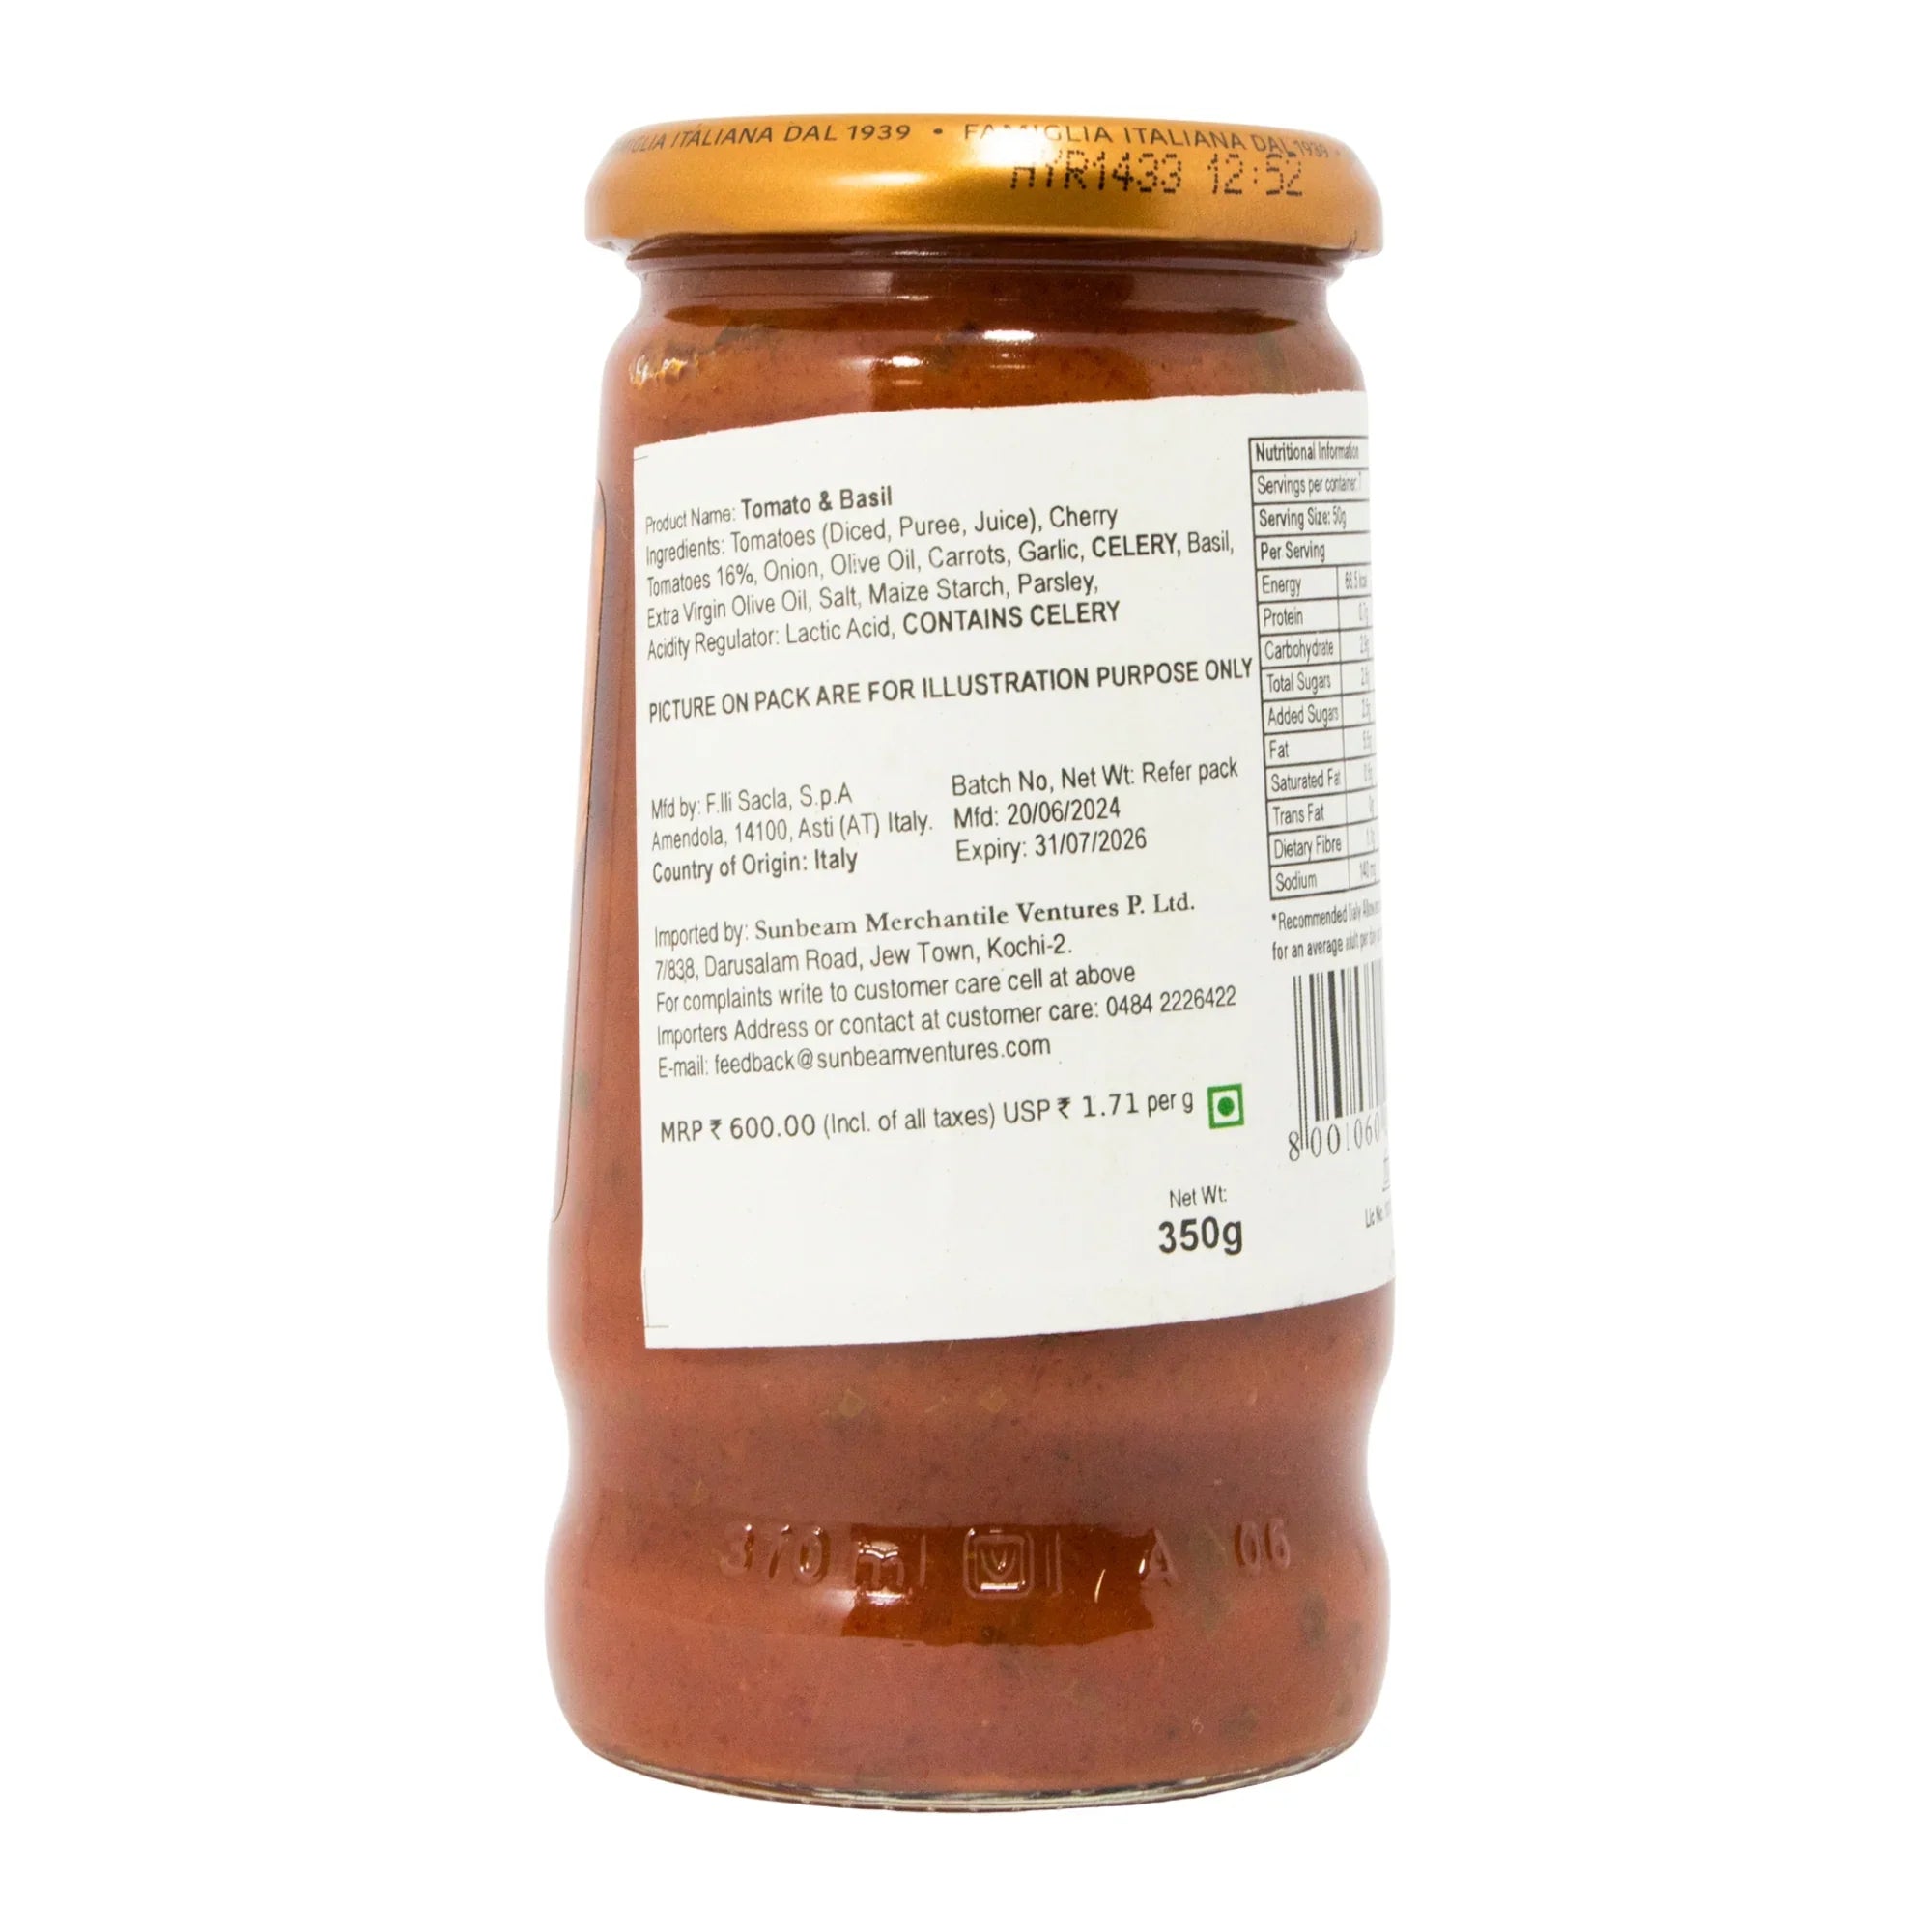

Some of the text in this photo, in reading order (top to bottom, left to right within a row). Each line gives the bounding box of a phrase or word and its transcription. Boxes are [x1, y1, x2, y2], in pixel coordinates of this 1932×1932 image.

[670, 122, 911, 148] ITALIANA DAL 1939
[1124, 128, 1246, 147] ITALIANA
[1253, 135, 1294, 154] DAL
[1206, 152, 1303, 195] 12:52
[1257, 440, 1359, 463] Nutritional Information
[1258, 475, 1322, 497] Servings per
[646, 485, 892, 532] Product Name: Tomato & Basil
[1260, 505, 1346, 530] Serving Size: 50g
[647, 505, 1118, 565] Ingredients: Tomatoes (Diced, Puree, Juice), Cherry
[1261, 539, 1325, 562] Per Serving
[647, 530, 1234, 596] Tomatoes 16%, Onion, Olive Oil, Carrots, Garlic, CELERY, Basil,
[648, 571, 1097, 628] Extra Virgin Olive Oil, Salt, Maize Starch, Parsley,
[1263, 576, 1301, 596] Energy
[648, 600, 1120, 661] Acidity Regulator: Lactic Acid, CONTAINS CELERY
[1264, 607, 1303, 626] Protein
[1265, 639, 1334, 665] Carbohydrate
[649, 657, 1252, 723] PICTURE ON PACK ARE FOR ILLUSTRATION PURPOSE ONLY
[1267, 670, 1331, 695] Total Sugars
[1268, 705, 1304, 725] Added
[1308, 701, 1339, 728] Sugars
[1269, 740, 1289, 759] Fat
[952, 756, 1238, 796] Batch No, Net Wt: Refer pack
[1271, 769, 1323, 792] Saturated
[1327, 769, 1341, 787] Fat
[652, 782, 852, 821] Mfd by: F.lli Sacla, S.p.A
[954, 796, 1121, 829] Mfd: 20/06/2024
[1273, 803, 1324, 825] Trans Fat
[652, 810, 933, 850] Amendola, 14100, Asti (AT) Italy.
[956, 827, 1147, 865] Expiry: 31/07/2026
[653, 847, 858, 884] Country of Origin: Italy
[1274, 837, 1312, 861] Dietary
[1316, 836, 1342, 853] Fibre
[1276, 871, 1317, 892] Sodium
[655, 892, 1194, 951] Imported by: Sunbeam Merchantile Ventures P. Ltd.
[705, 952, 799, 977] Darusalam
[806, 947, 863, 971] Road,
[870, 945, 910, 967] Jew
[917, 942, 980, 963] Town,
[987, 933, 1071, 958] Kochi-2.
[1273, 938, 1343, 961] for an average
[657, 964, 1135, 1014] For complaints write to customer care cell at above
[658, 984, 1236, 1049] Importers Address or contact at customer care: 0484 2226422
[659, 1038, 1051, 1078] E-mail: feedback@sunbeamventures.com
[662, 1120, 702, 1143] MRP
[730, 1114, 815, 1139] 600.00
[824, 1111, 870, 1139] (Incl.
[878, 1109, 896, 1131] of
[905, 1108, 926, 1130] all
[933, 1103, 995, 1129] taxes)
[1004, 1099, 1050, 1123] USP
[1083, 1092, 1139, 1118] 1.71
[1148, 1094, 1177, 1118] per
[1182, 1092, 1193, 1114] g
[1170, 1185, 1227, 1208] Net Wt:
[1159, 1216, 1242, 1256] 350g
